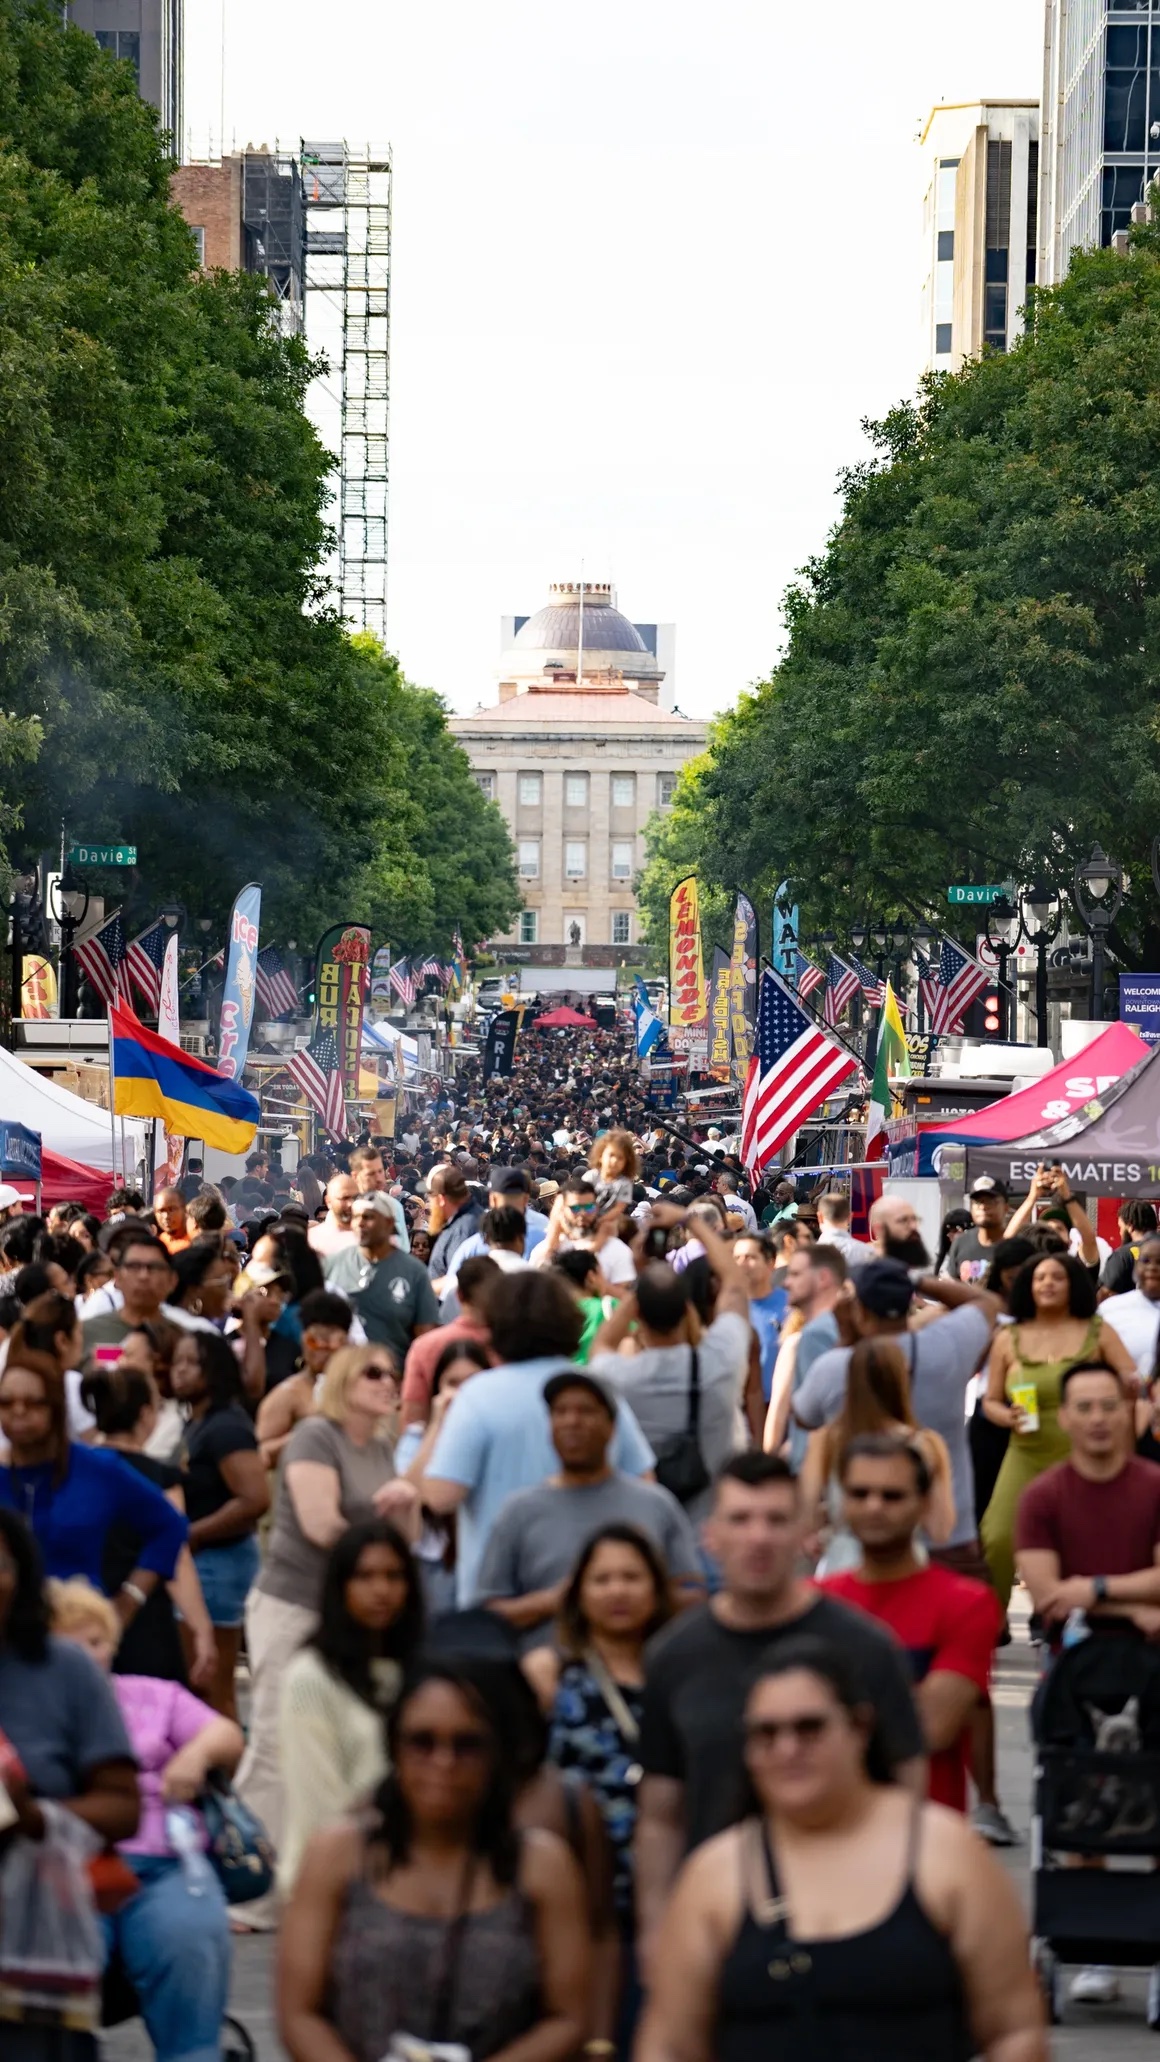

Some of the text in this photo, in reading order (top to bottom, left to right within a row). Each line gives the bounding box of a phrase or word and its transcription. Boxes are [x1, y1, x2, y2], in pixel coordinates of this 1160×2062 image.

[79, 846, 137, 863] Davie St
[948, 886, 953, 894] E
[233, 910, 258, 954] ice
[675, 886, 702, 1021] LEMONADE
[217, 1000, 240, 1080] cre
[684, 1028, 707, 1037] MINI
[905, 1033, 930, 1054] ROS
[1041, 1100, 1071, 1120] &
[1010, 1161, 1141, 1182] ESMATES
